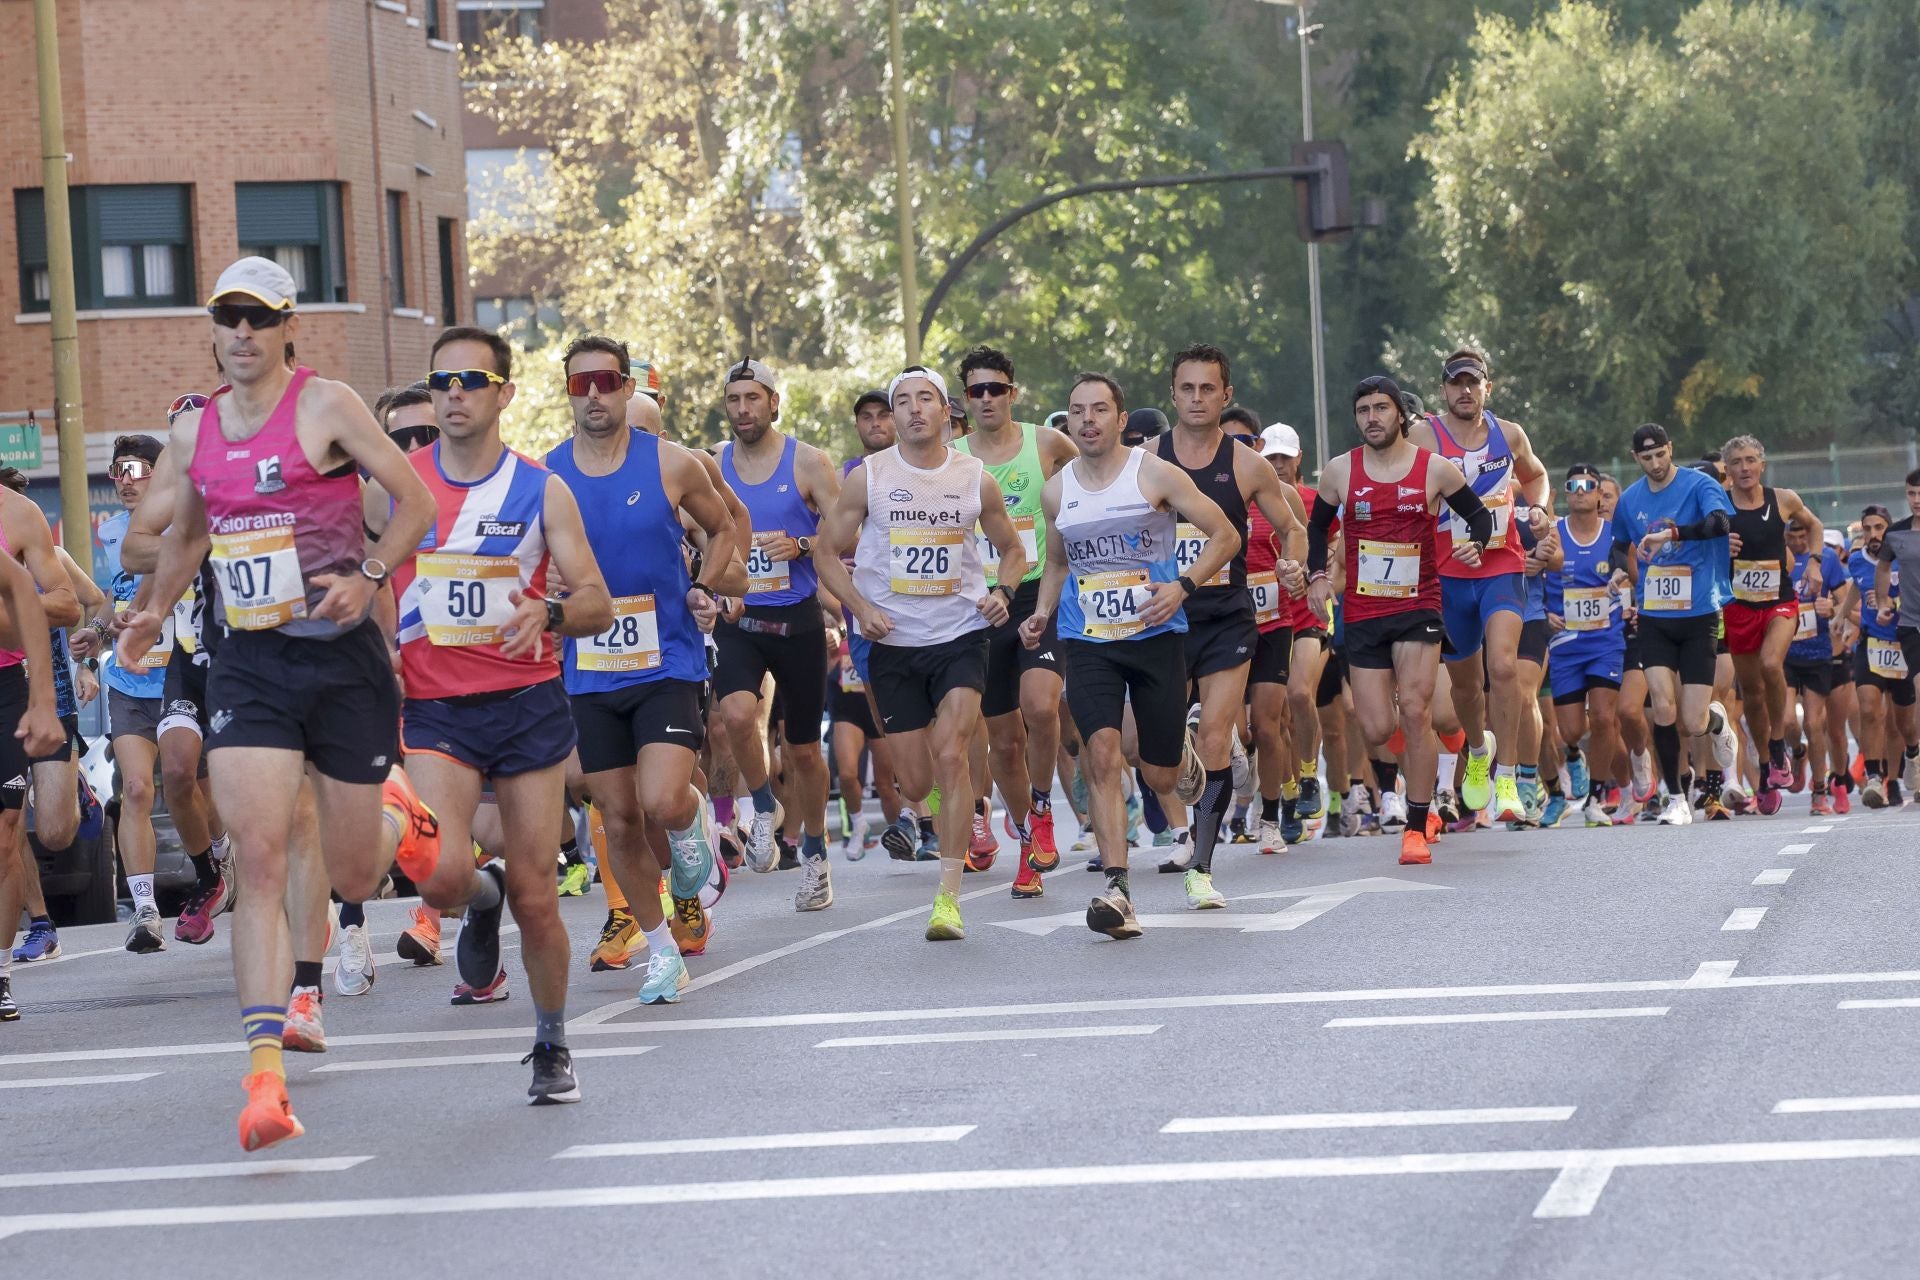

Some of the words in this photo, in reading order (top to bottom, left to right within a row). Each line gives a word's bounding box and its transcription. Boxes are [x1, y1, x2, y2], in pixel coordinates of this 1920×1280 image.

[1481, 457, 1507, 472] Toscaf
[890, 510, 960, 525] mueve-t
[482, 522, 521, 535] Toscaf
[906, 547, 948, 573] 226
[1176, 539, 1209, 565] 43
[227, 556, 271, 599] 407
[1383, 558, 1394, 580] 7
[1655, 578, 1680, 596] 130
[1742, 571, 1770, 589] 422
[448, 580, 486, 618] 50
[1092, 588, 1137, 618] 254
[1575, 600, 1600, 617] 135
[1877, 649, 1900, 667] 102
